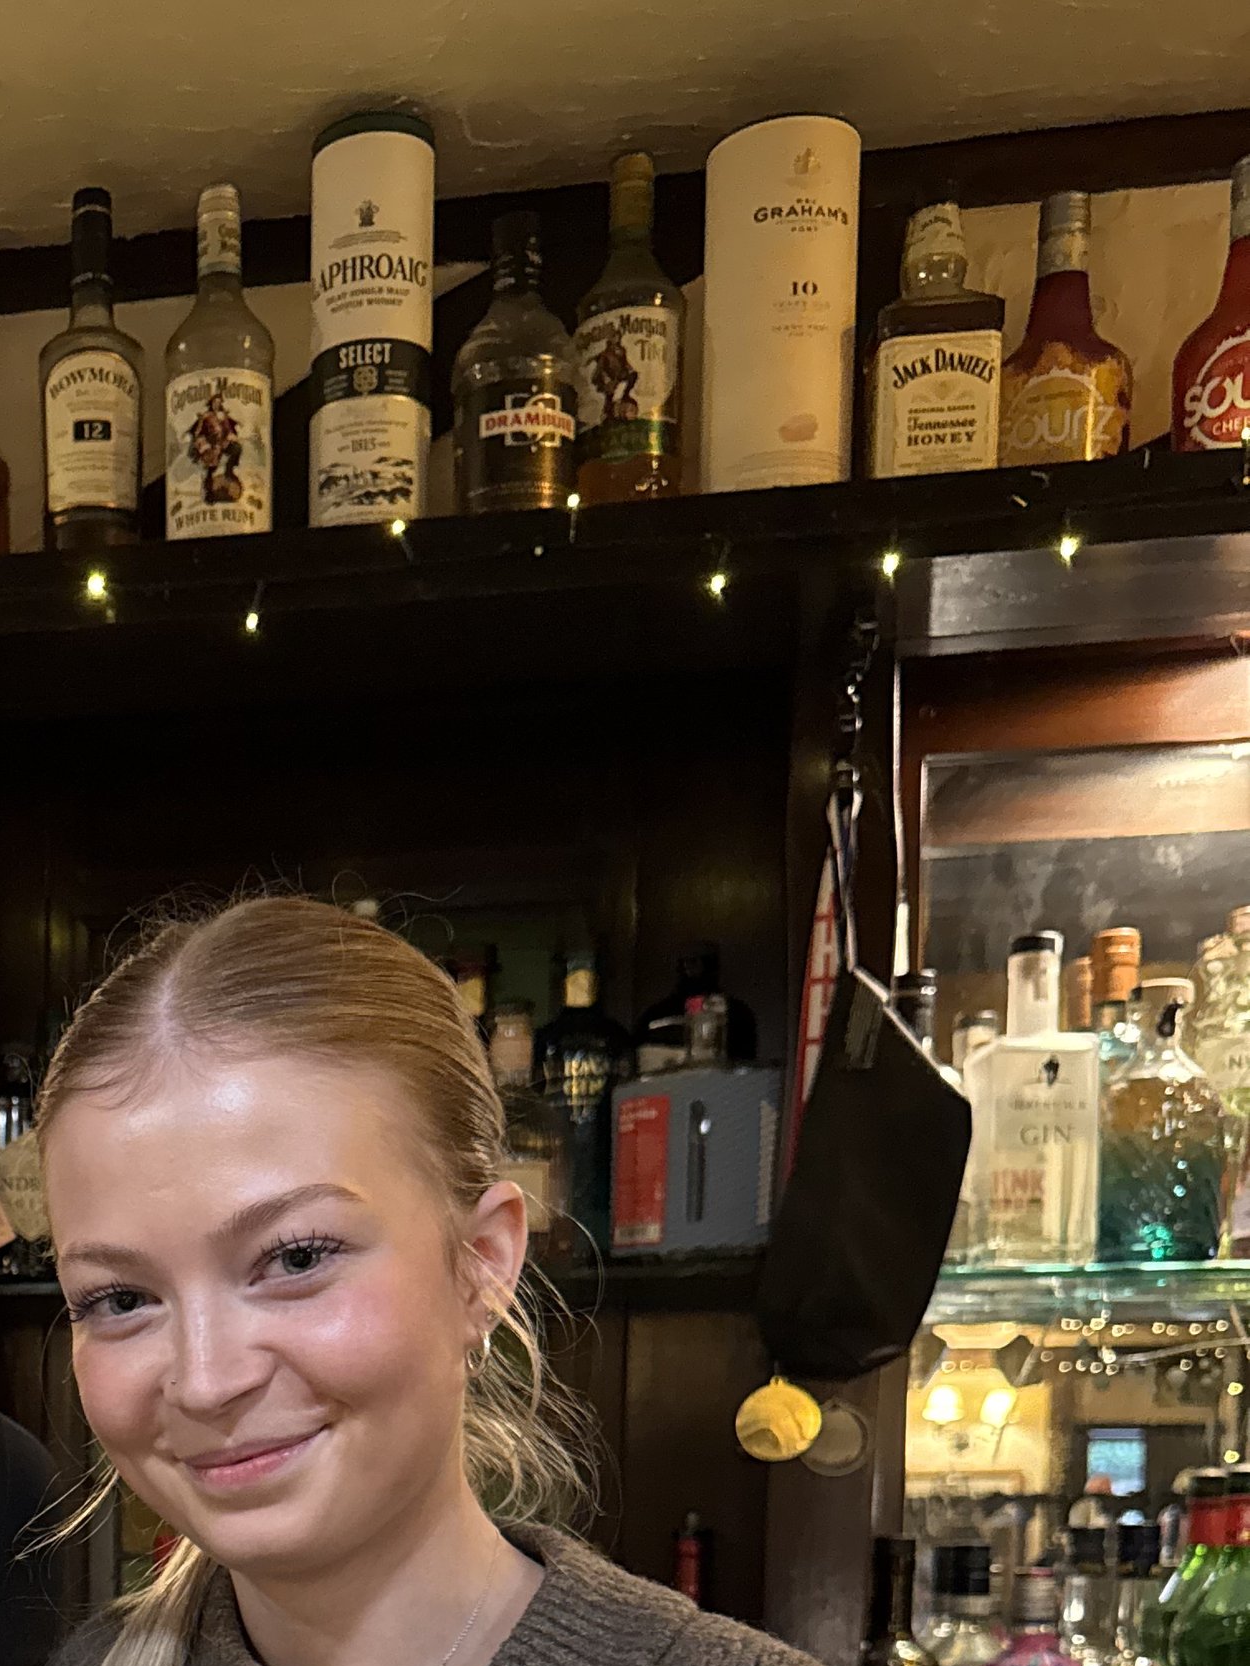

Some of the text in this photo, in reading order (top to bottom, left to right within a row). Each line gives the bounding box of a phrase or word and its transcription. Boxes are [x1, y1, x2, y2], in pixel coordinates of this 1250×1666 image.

[753, 206, 848, 225] GRAHAM'S
[792, 280, 818, 297] 10
[339, 343, 392, 370] SELECT
[892, 356, 932, 390] JACK
[83, 422, 103, 439] 12
[907, 431, 976, 447] HONEY
[175, 509, 217, 531] WHITE
[1019, 1124, 1072, 1146] GIN
